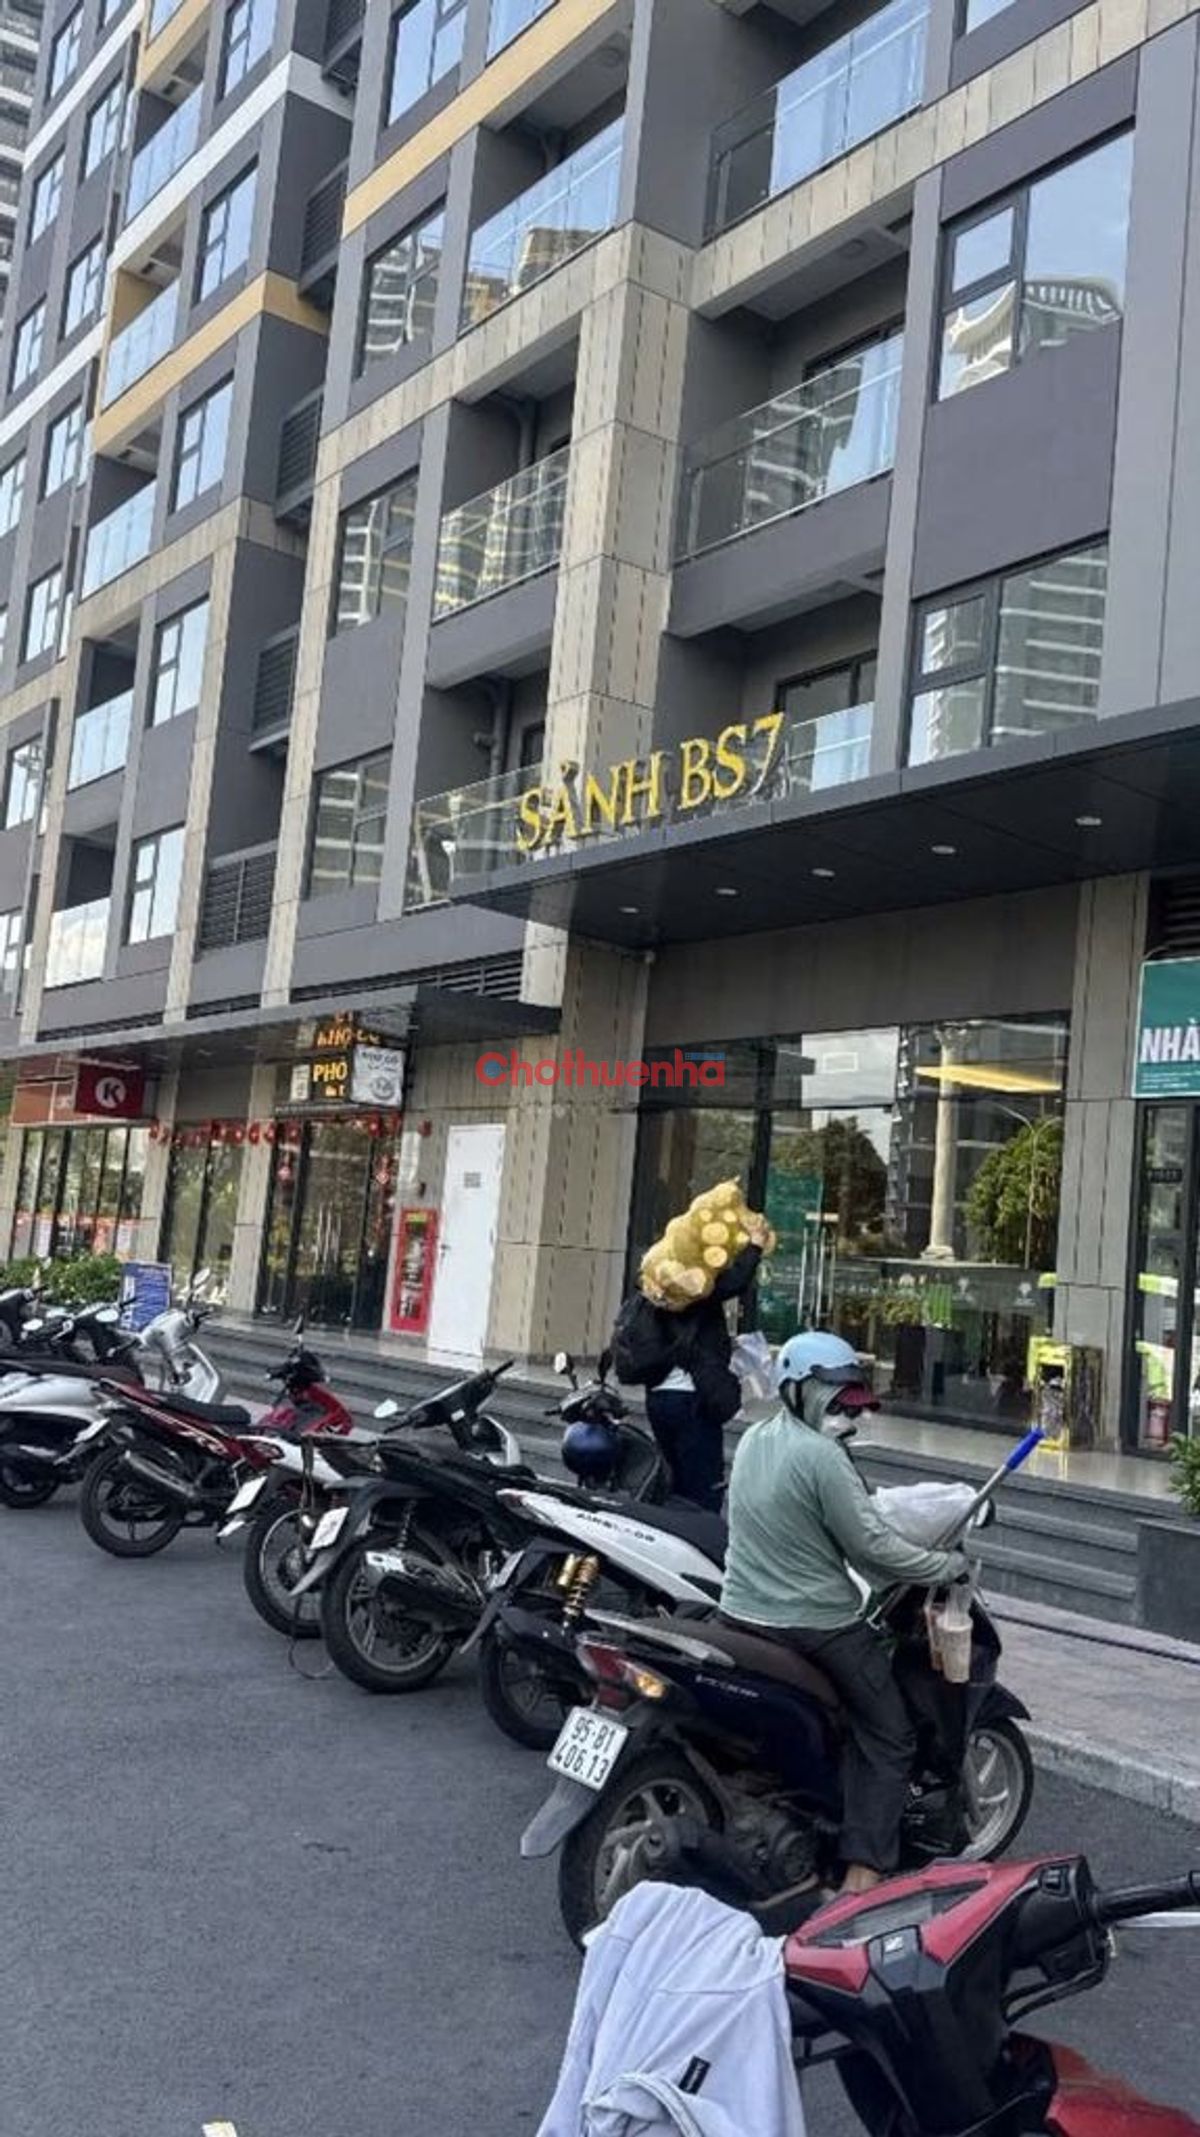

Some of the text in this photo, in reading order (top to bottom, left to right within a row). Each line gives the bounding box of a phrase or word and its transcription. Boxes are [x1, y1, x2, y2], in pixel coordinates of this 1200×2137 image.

[516, 711, 785, 850] SẢNH BS7
[1140, 1018, 1200, 1063] NHÀ
